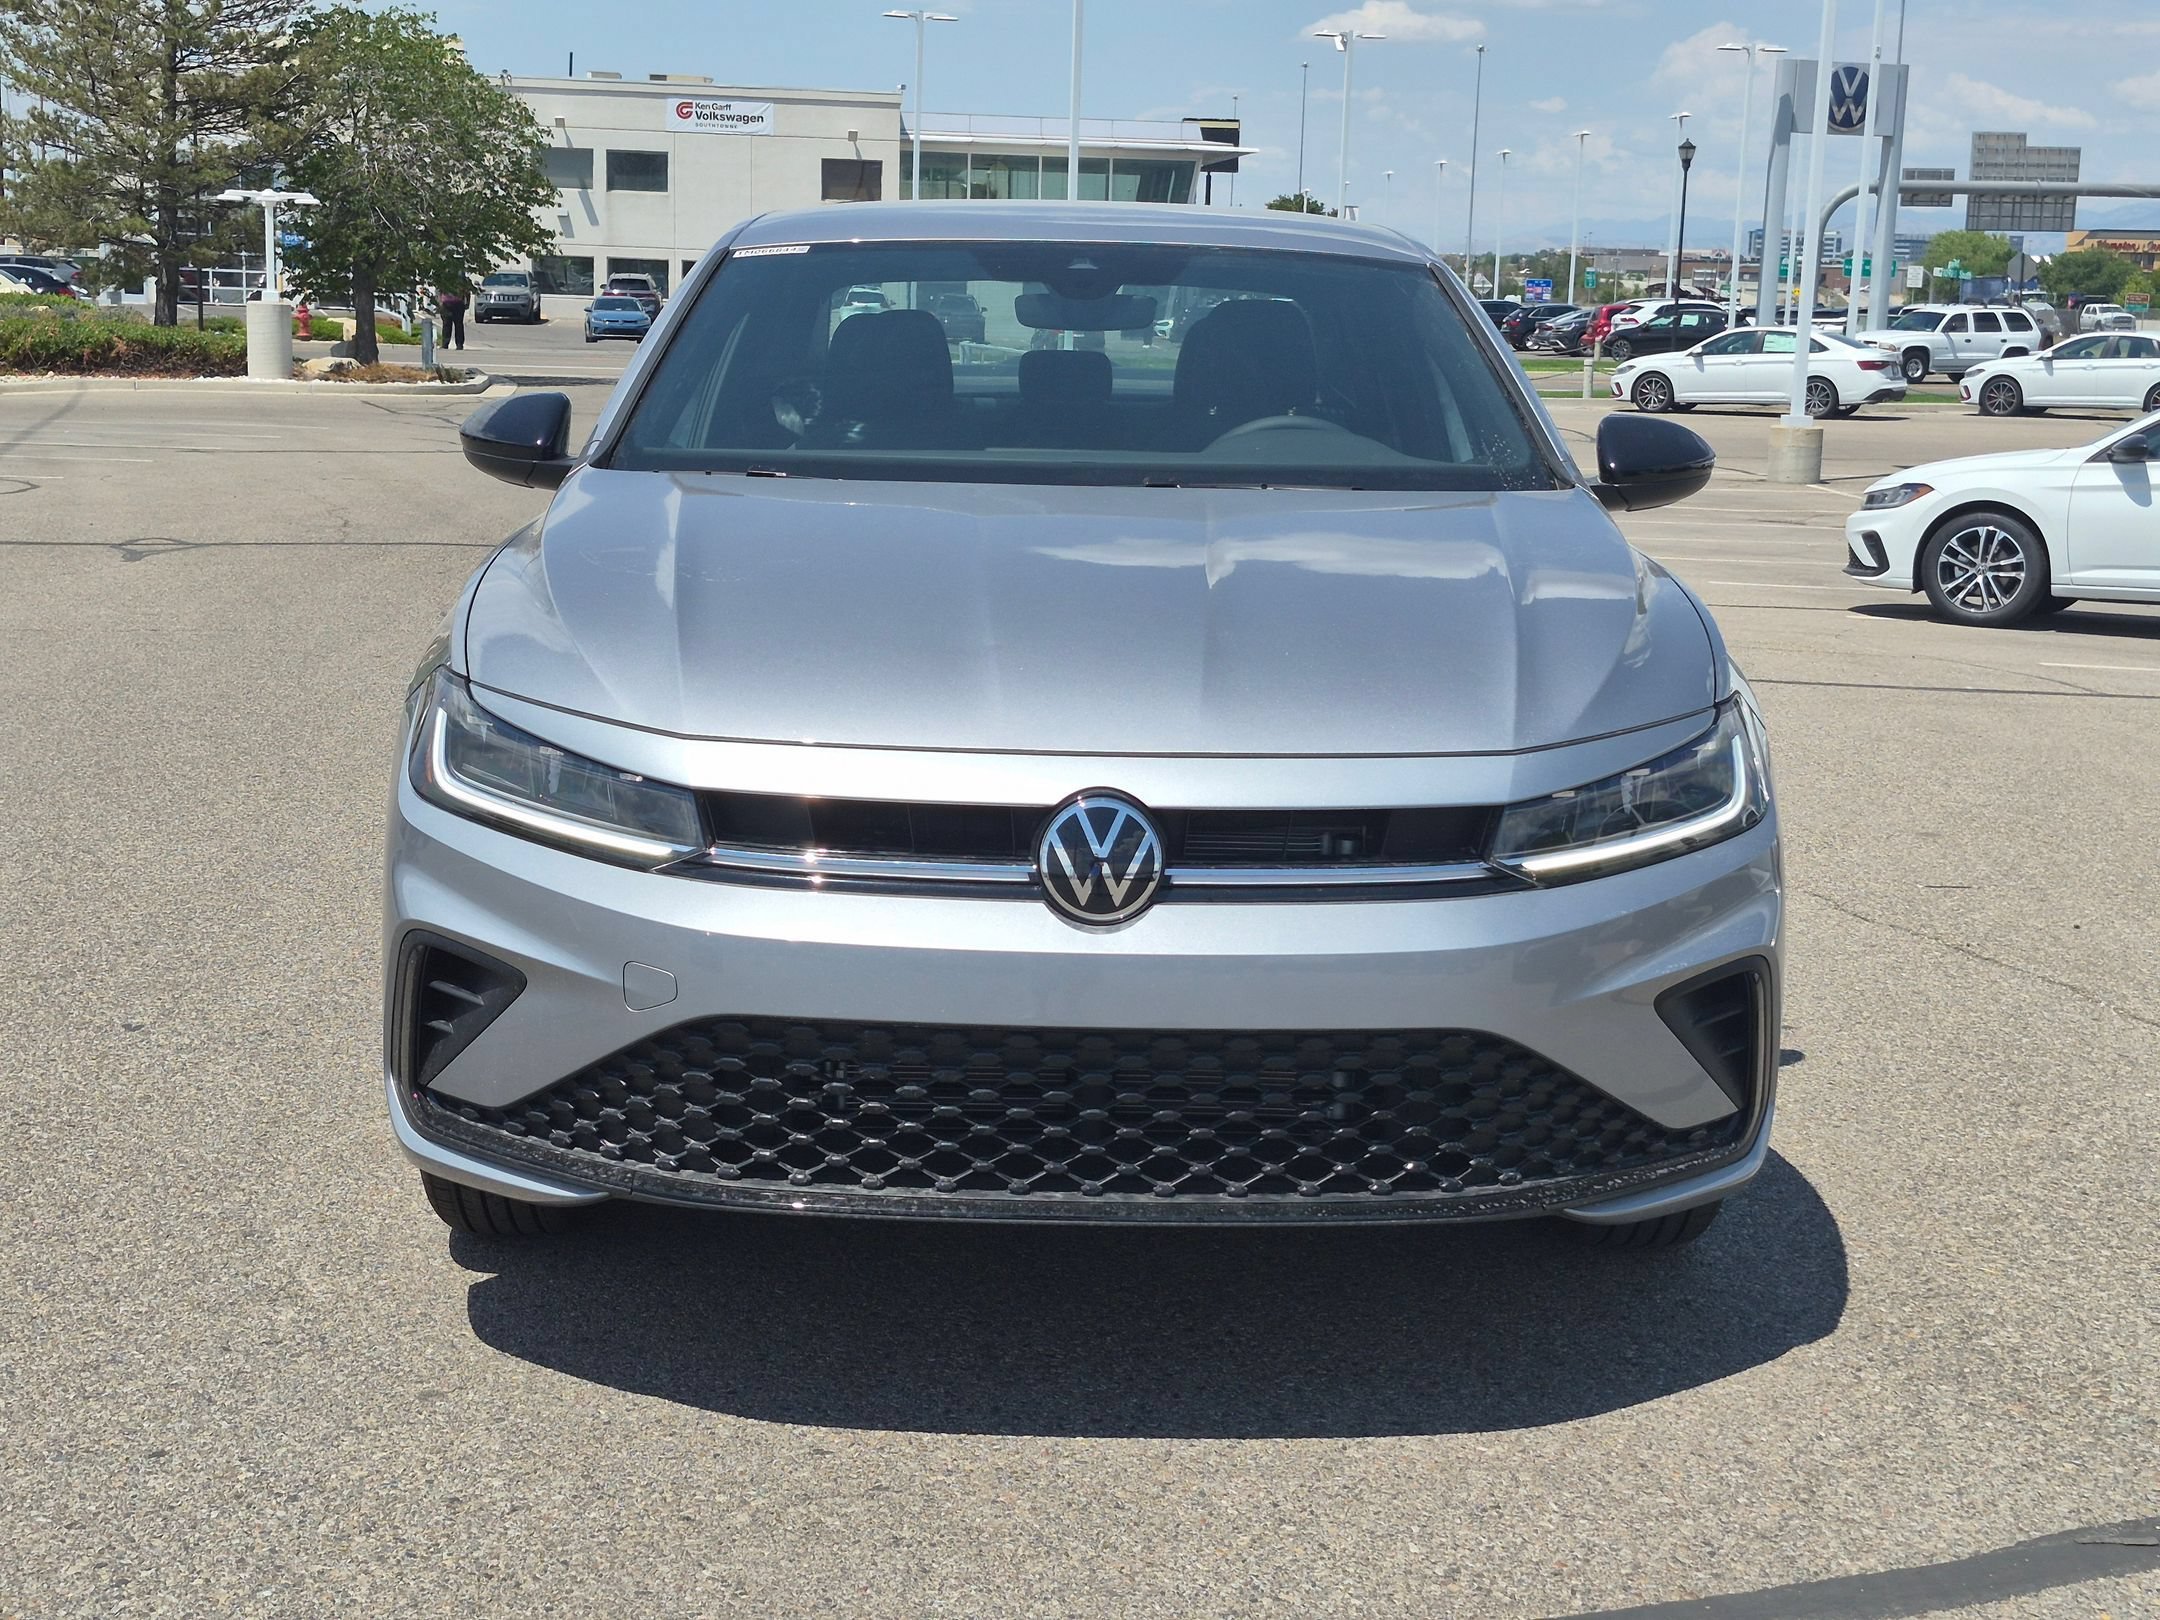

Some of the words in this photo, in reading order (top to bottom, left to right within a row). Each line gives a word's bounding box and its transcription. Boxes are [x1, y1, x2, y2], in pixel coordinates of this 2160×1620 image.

[695, 102, 710, 110] Ken
[711, 103, 731, 111] Garff
[695, 111, 764, 124] Volkswagen
[1047, 798, 1154, 908] VW
